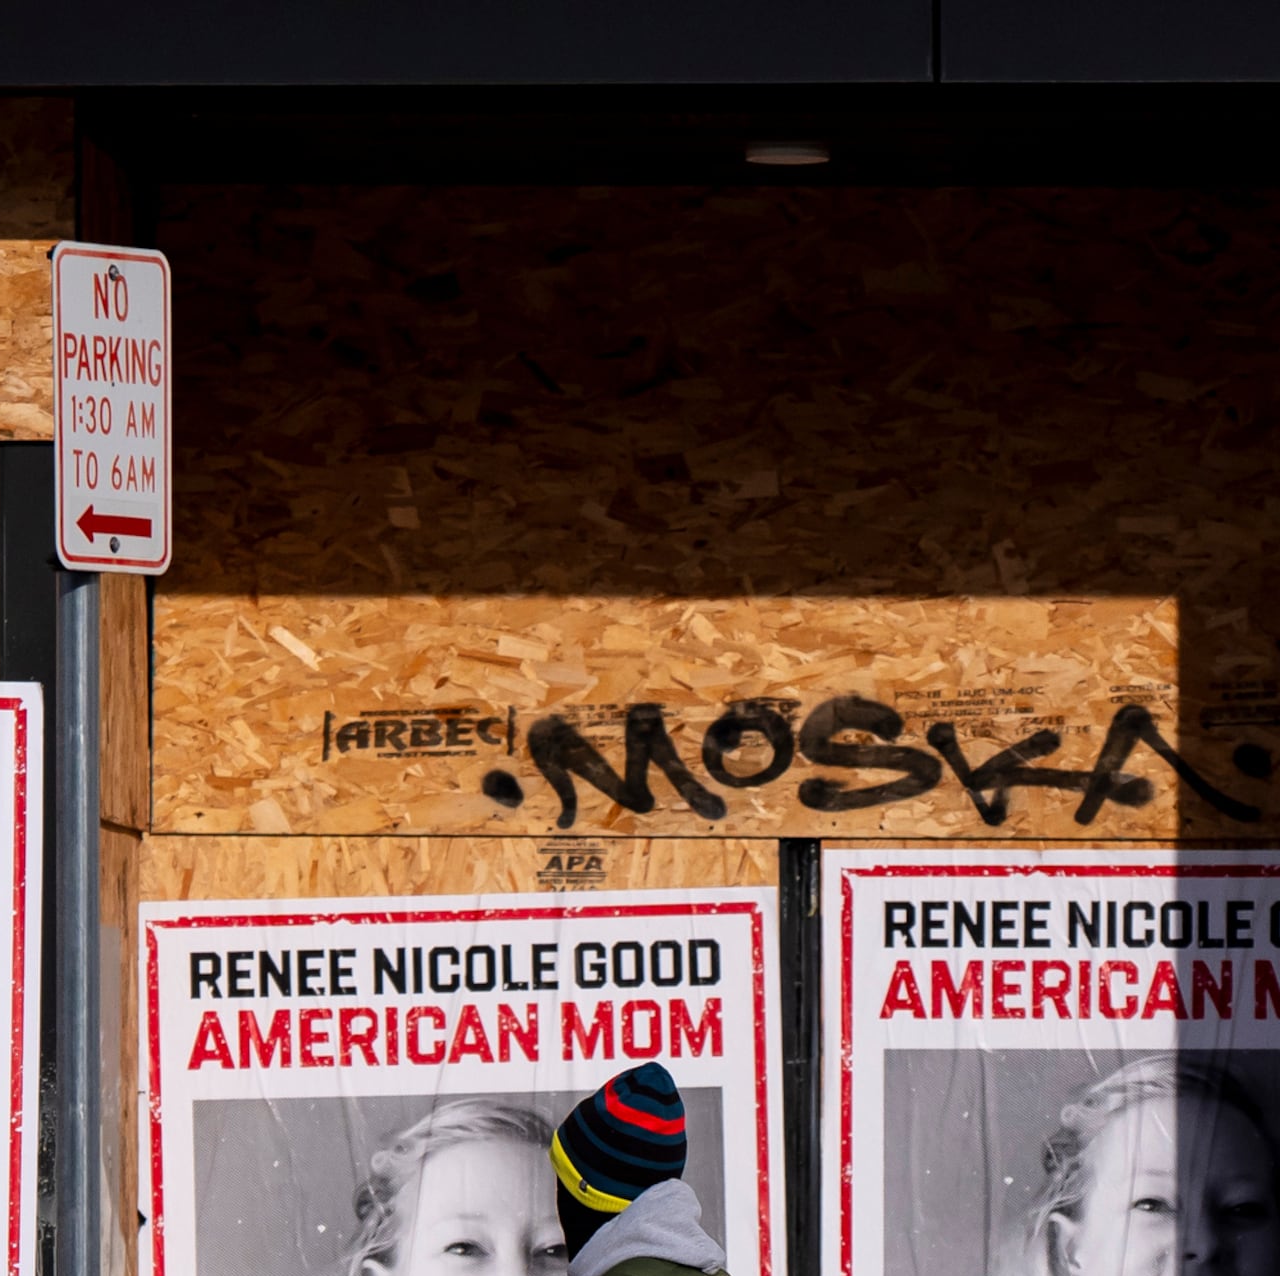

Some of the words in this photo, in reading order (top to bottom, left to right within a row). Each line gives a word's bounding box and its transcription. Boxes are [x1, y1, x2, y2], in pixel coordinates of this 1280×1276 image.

[93, 272, 129, 322] NO
[63, 332, 162, 387] PARKING
[71, 395, 112, 435] 1:30
[126, 400, 156, 439] AM
[73, 449, 99, 490] TO
[336, 717, 503, 753] ARBEC
[545, 856, 603, 870] APA
[885, 901, 1050, 947] RENEE
[1069, 901, 1254, 948] NICOLE
[191, 949, 356, 998] RENEE
[374, 944, 558, 994] NICOLE
[575, 939, 720, 988] GOOD
[880, 960, 1232, 1019] AMERICAN
[188, 1003, 539, 1070] AMERICAN
[562, 998, 723, 1060] MOM
